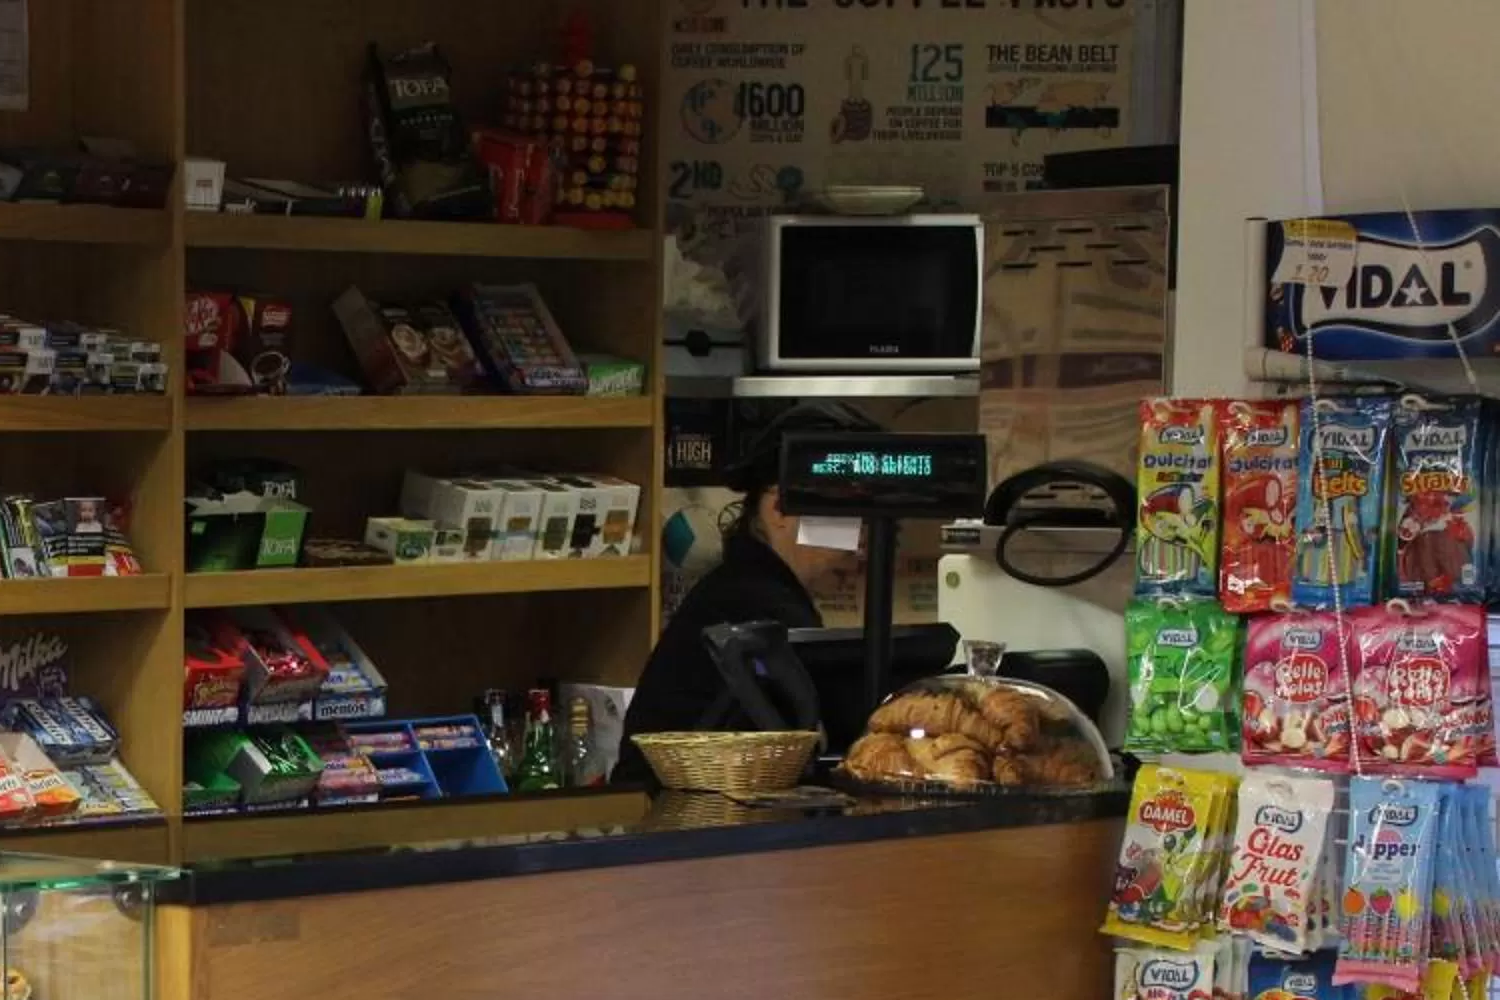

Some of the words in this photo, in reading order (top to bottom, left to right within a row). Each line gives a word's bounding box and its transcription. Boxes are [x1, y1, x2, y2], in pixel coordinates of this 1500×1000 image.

[911, 44, 964, 82] 125
[986, 44, 1020, 62] THE
[1025, 44, 1072, 62] BEAN
[1078, 44, 1119, 62] BELT
[676, 440, 712, 461] HIGH
[321, 702, 365, 716] mentos
[1142, 805, 1189, 823] DAMEL
[1247, 827, 1305, 862] Glas
[1351, 834, 1421, 861] dpper
[1233, 853, 1299, 886] Frut
[1151, 967, 1193, 983] VIDAL
